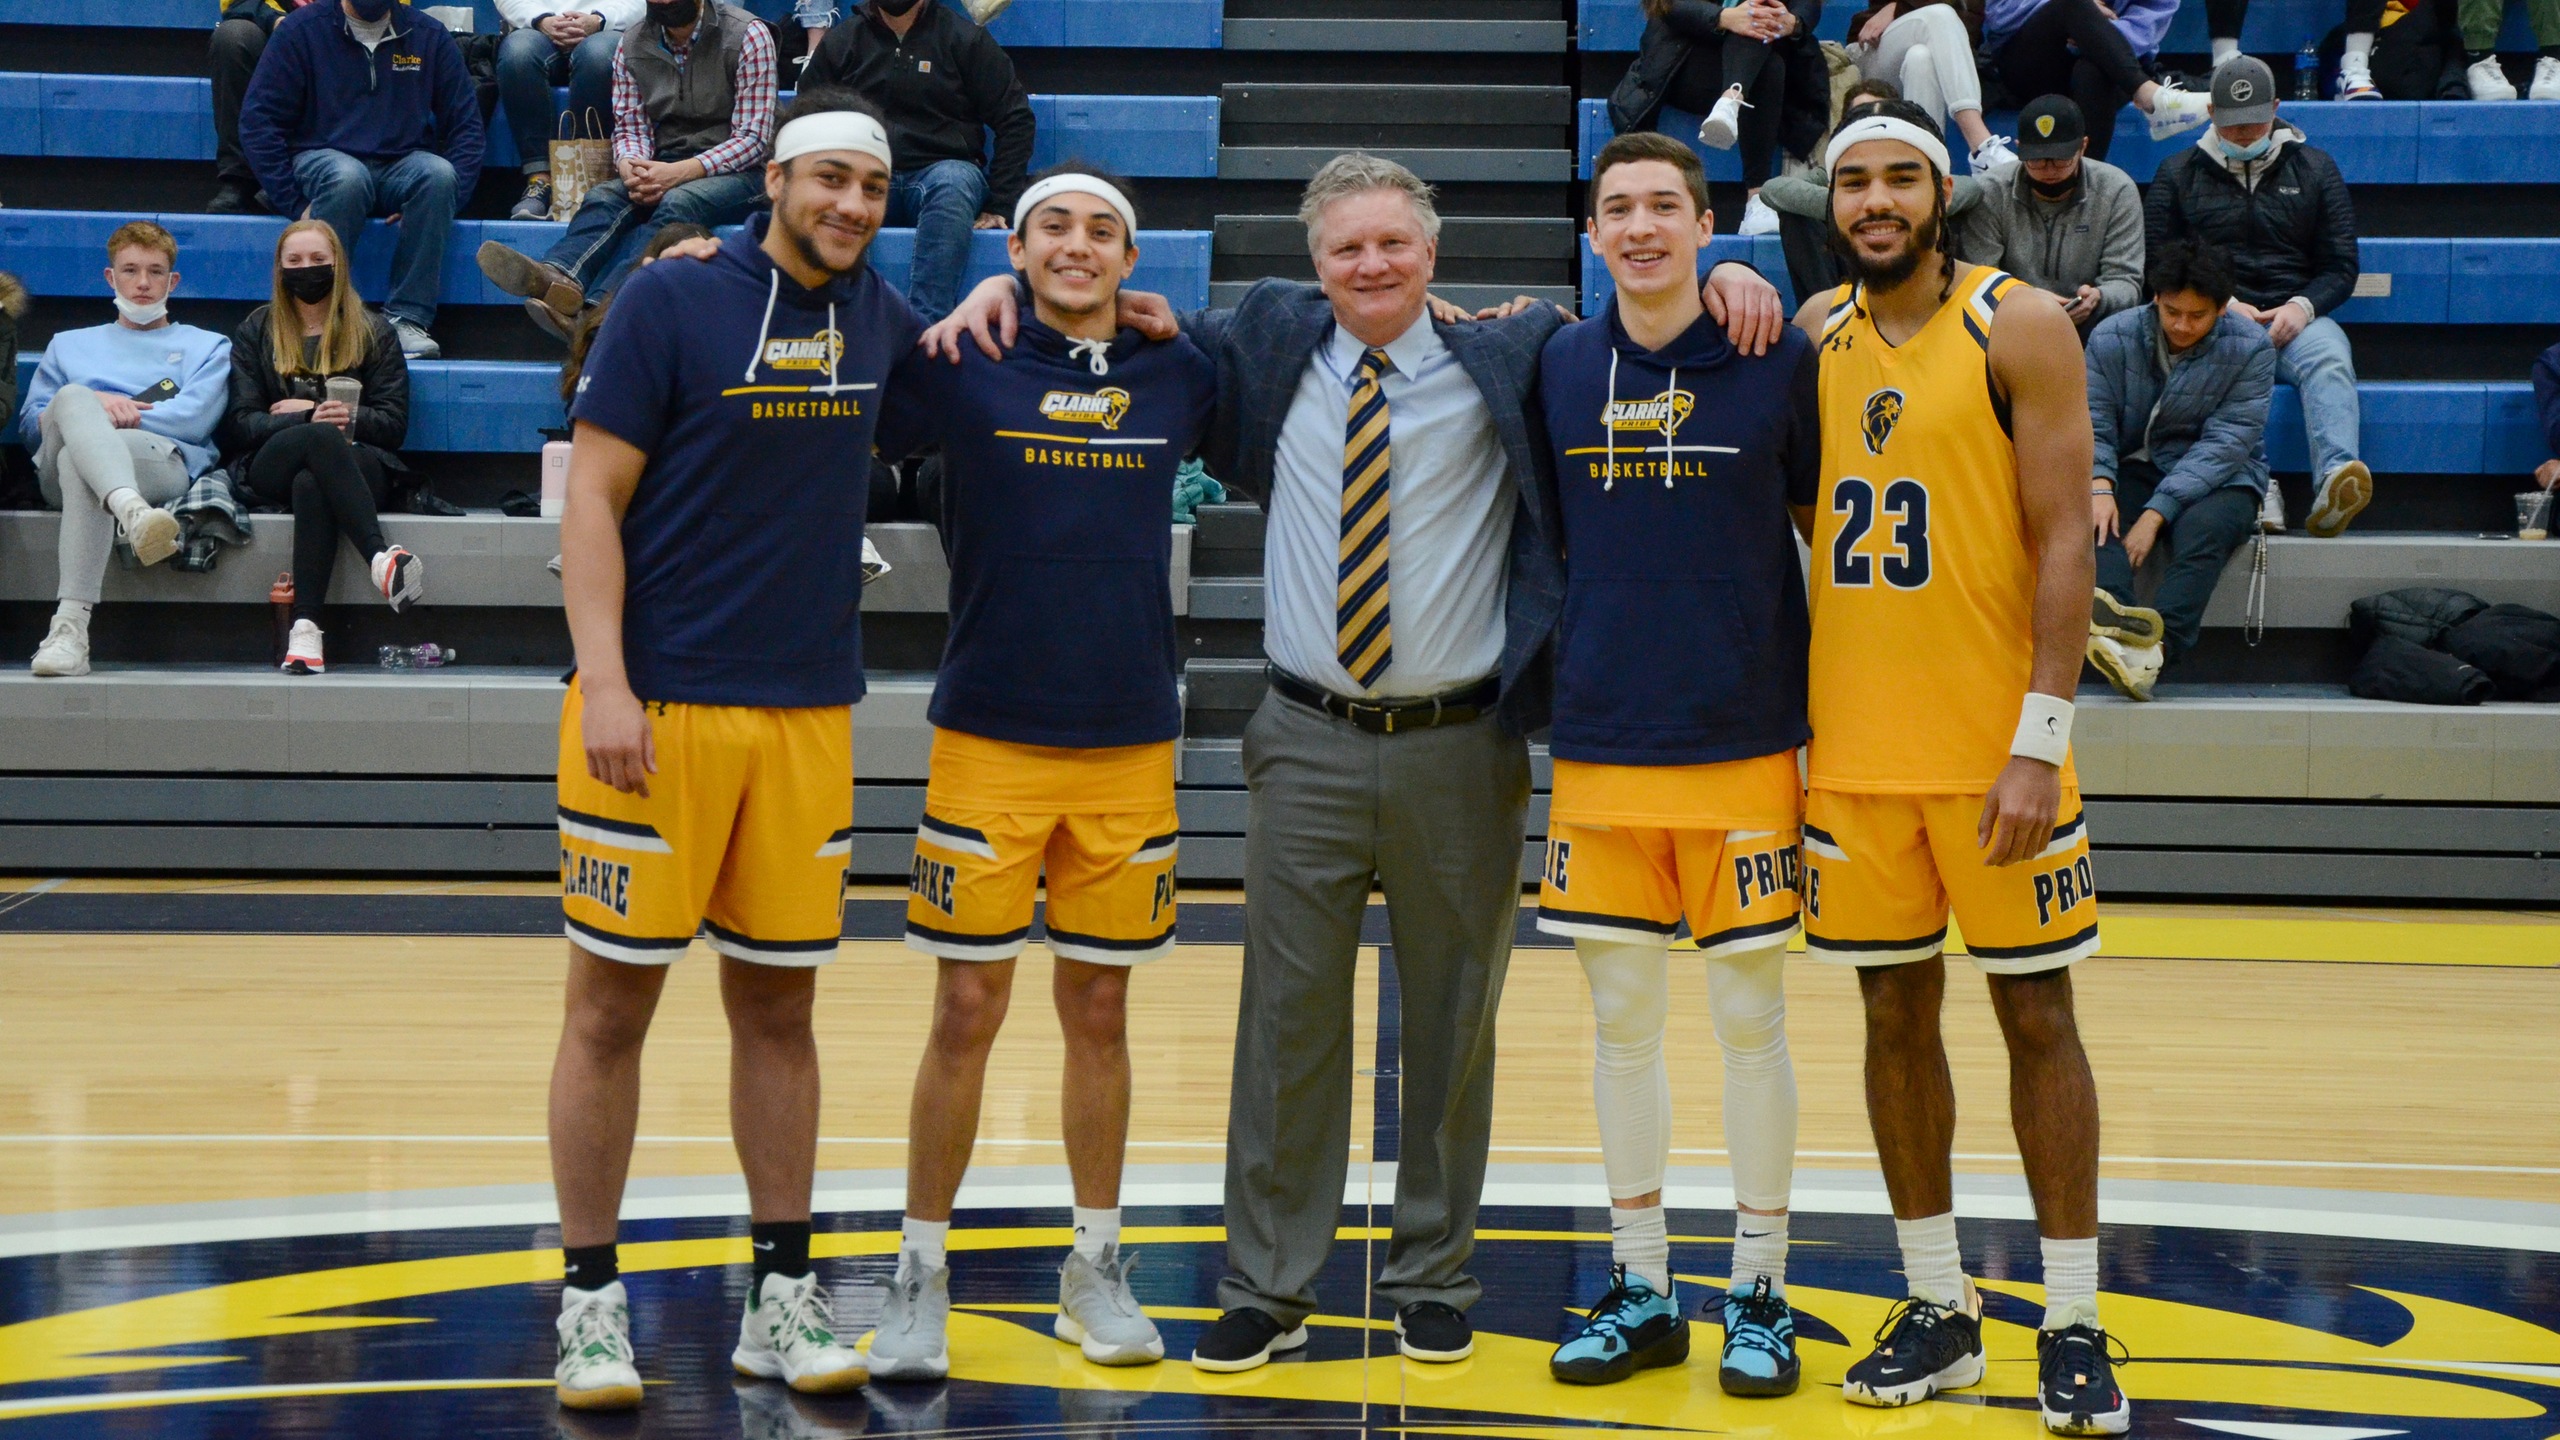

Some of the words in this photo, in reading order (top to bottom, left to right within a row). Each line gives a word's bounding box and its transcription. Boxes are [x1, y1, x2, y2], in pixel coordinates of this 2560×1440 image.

[392, 53, 422, 64] Clarke
[765, 341, 827, 361] CLARKE
[752, 401, 861, 419] BASKETBALL
[1042, 393, 1111, 413] CLARKE
[1603, 402, 1670, 422] CLARKE
[1063, 411, 1095, 419] PRIDE
[1025, 447, 1145, 469] BASKETBALL
[1589, 461, 1708, 478] BASKETBALL
[1833, 476, 1932, 590] 23
